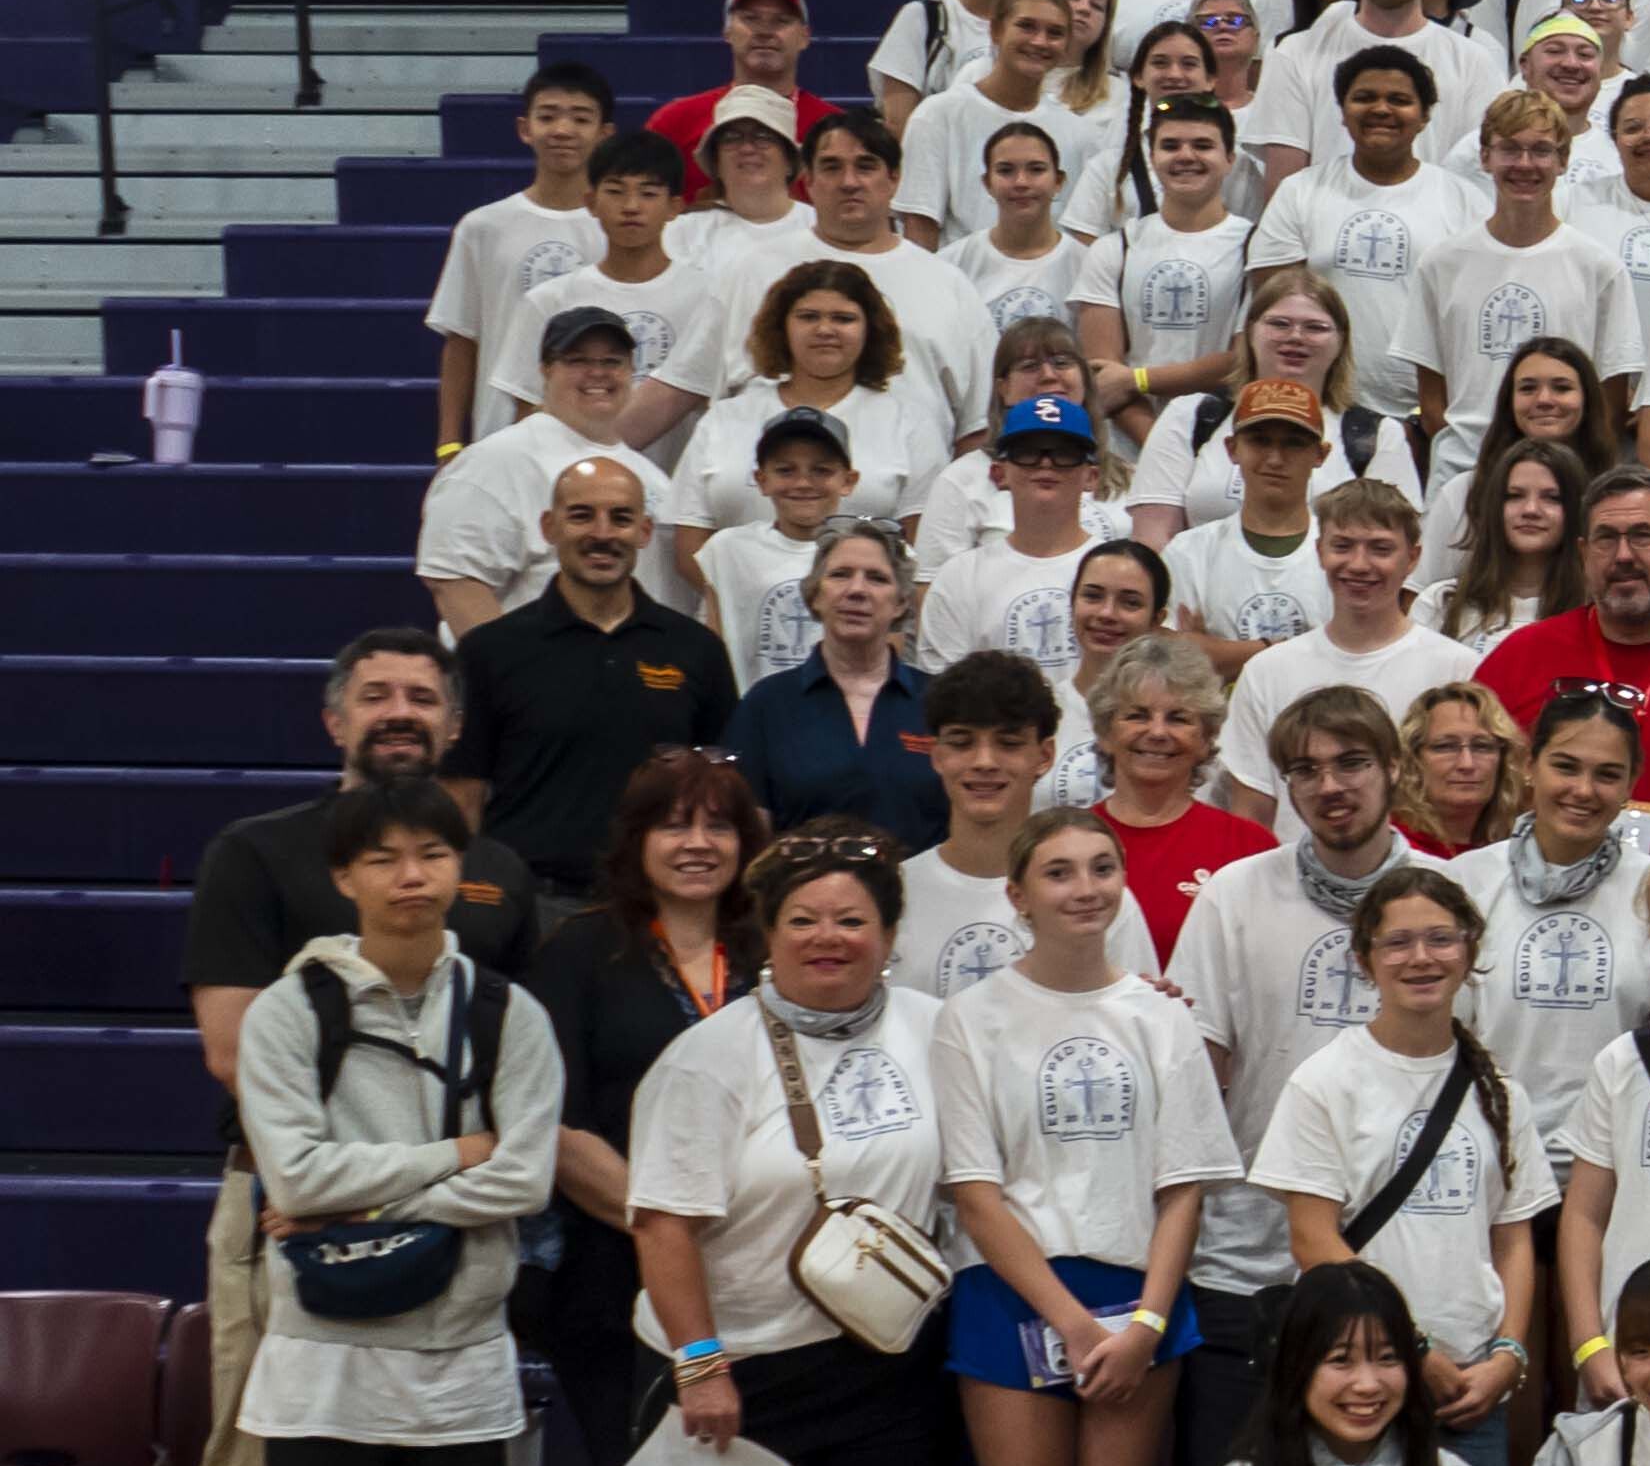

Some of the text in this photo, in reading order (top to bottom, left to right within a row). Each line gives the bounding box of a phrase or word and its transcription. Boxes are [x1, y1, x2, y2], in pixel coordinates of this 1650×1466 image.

[1515, 289, 1529, 299] TO
[1303, 935, 1345, 1008] EQUIPPED
[1520, 918, 1605, 994] EQUIPPED TO THRIVE
[1045, 1044, 1129, 1126] EQUIPPED TO THRIVE
